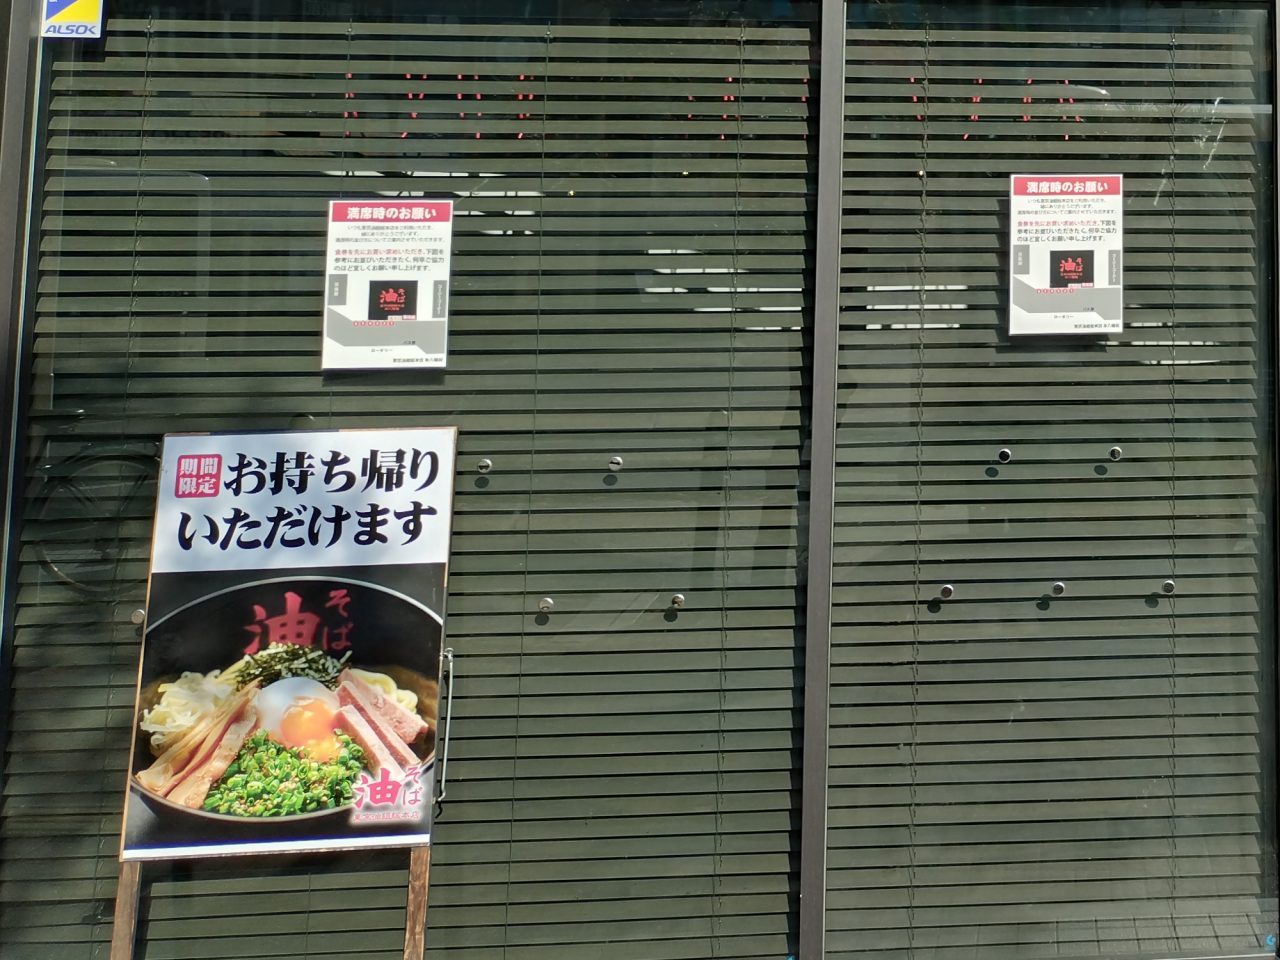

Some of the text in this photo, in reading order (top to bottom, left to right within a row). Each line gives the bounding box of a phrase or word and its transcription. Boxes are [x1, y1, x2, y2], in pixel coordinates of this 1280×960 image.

[45, 24, 96, 35] ALSOK
[1026, 181, 1108, 193] 満席時のお願い
[347, 207, 436, 220] 満席時のお願い
[179, 456, 218, 476] 期間
[223, 447, 441, 497] お持ち帰り
[179, 476, 218, 496] 限定
[176, 500, 438, 551] いただけます
